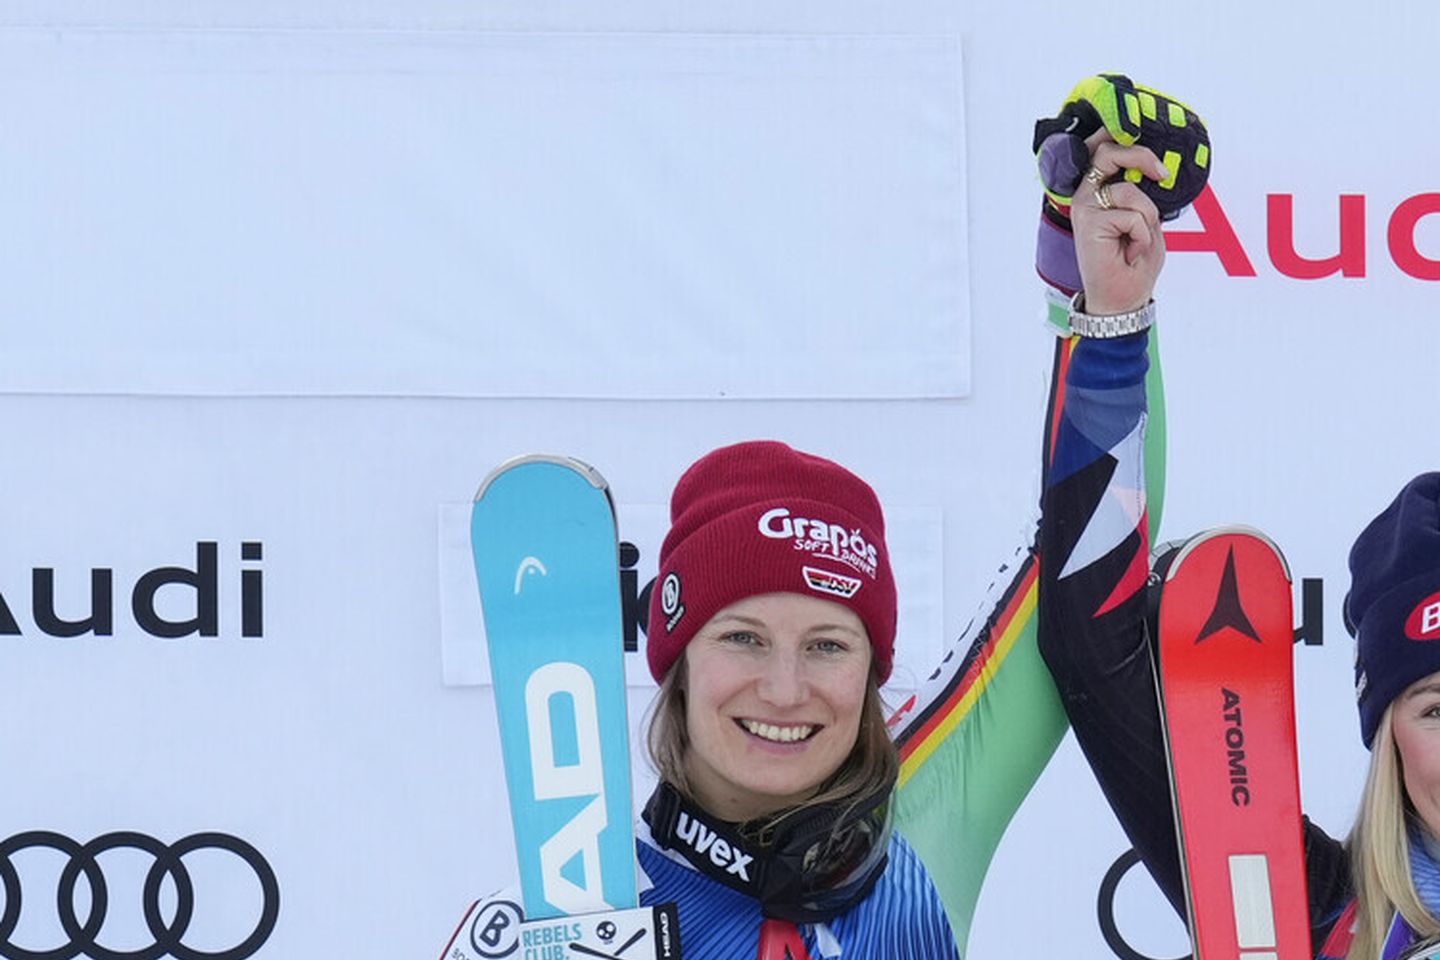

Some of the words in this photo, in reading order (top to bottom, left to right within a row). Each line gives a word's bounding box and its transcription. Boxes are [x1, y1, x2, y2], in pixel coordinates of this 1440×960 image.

[793, 539, 830, 553] SOFT
[0, 541, 263, 638] udi
[1220, 687, 1250, 807] ATOMIC
[676, 812, 753, 881] uvex
[523, 923, 582, 947] REBELS
[660, 911, 671, 957] HEAD
